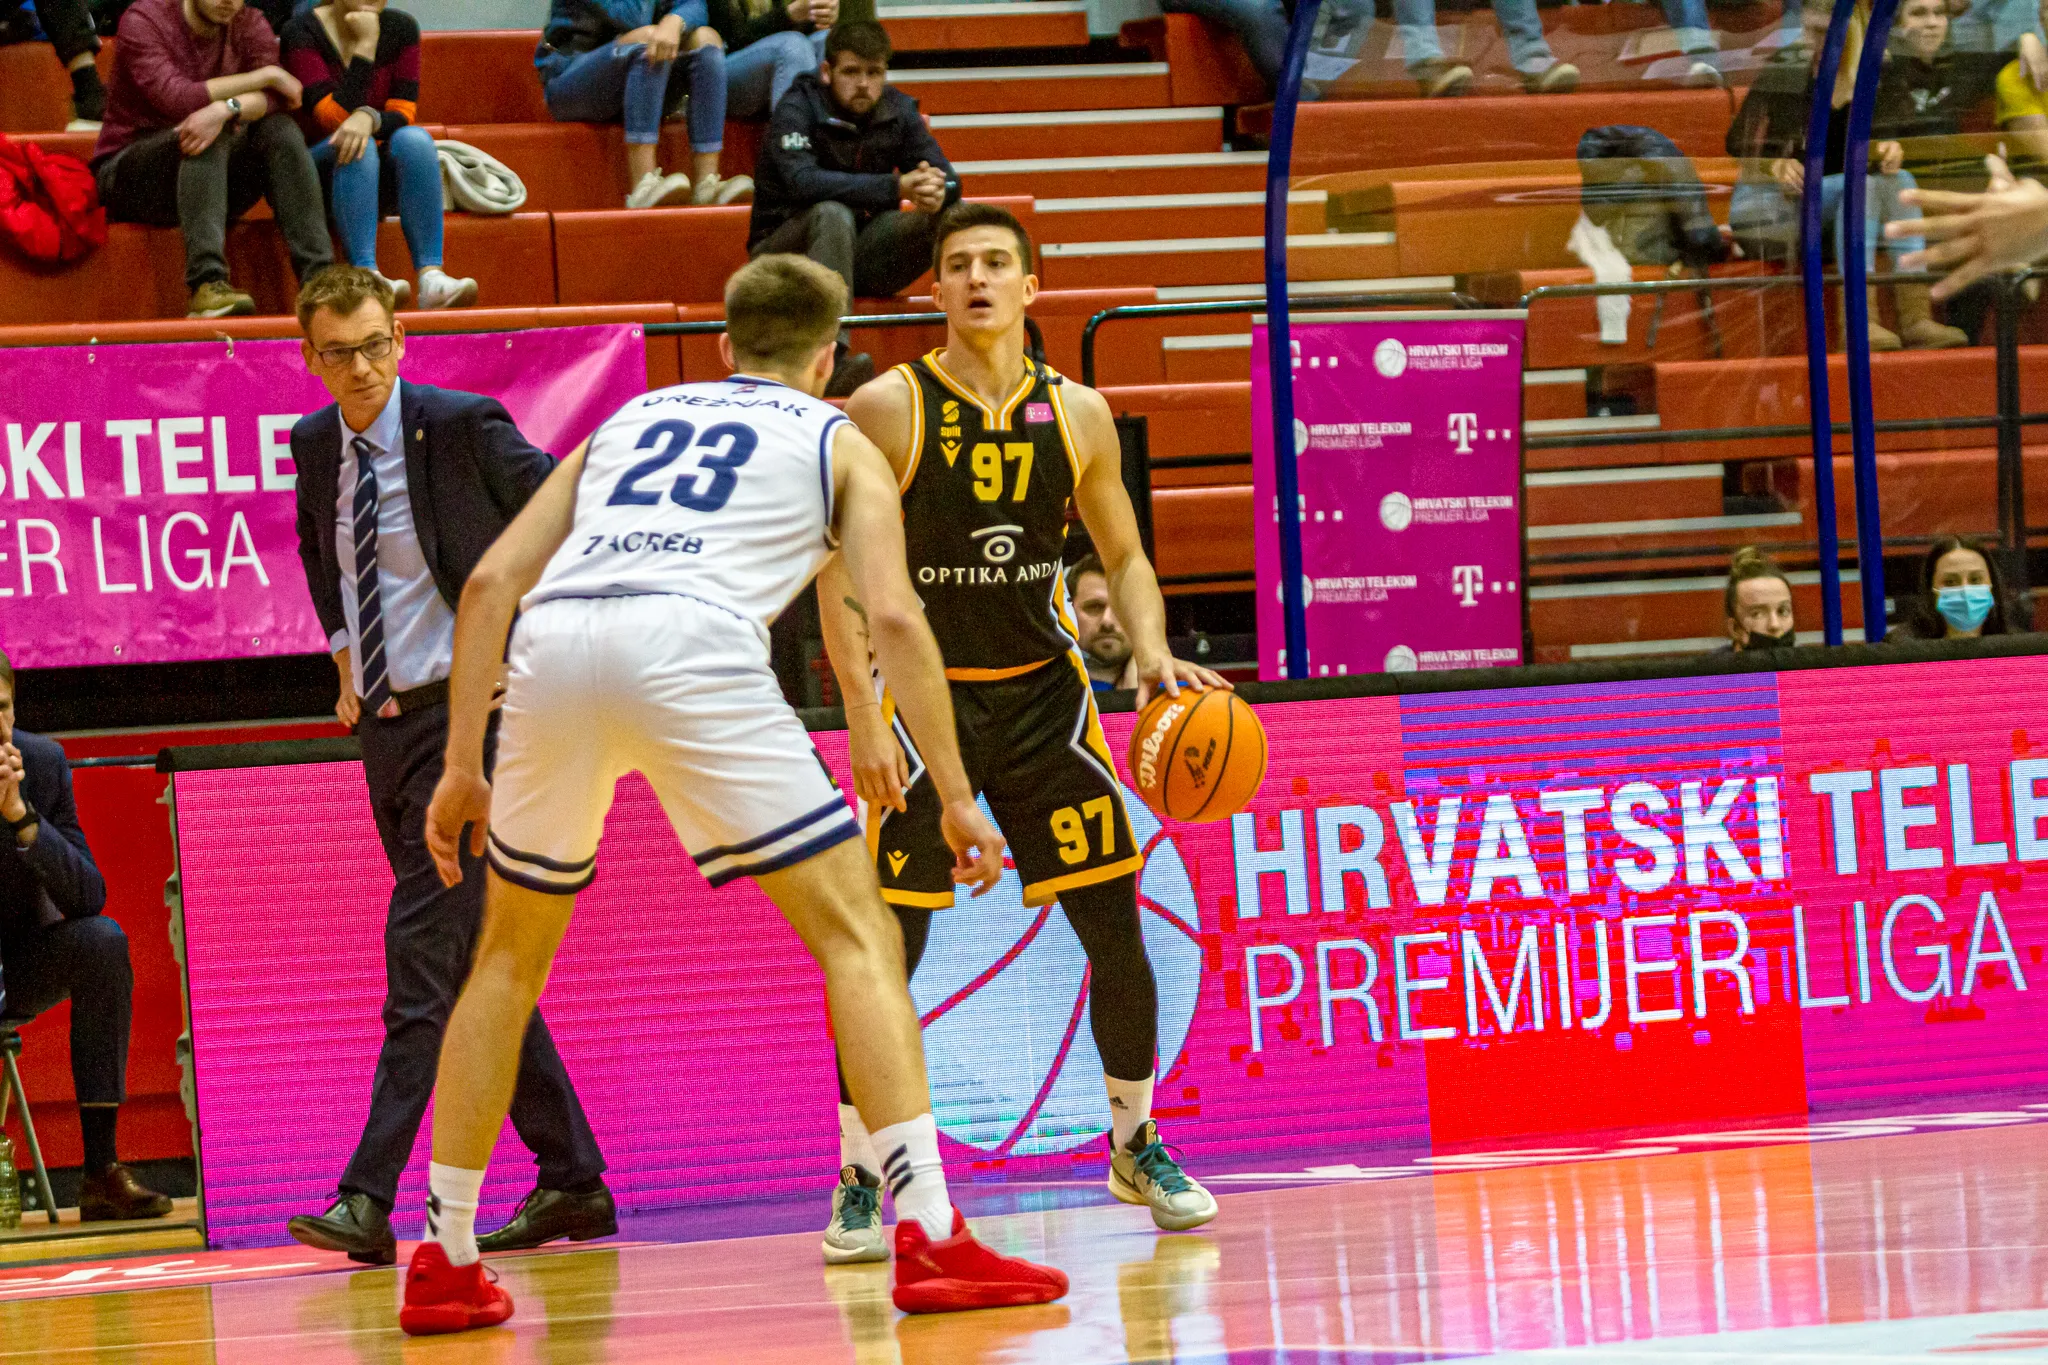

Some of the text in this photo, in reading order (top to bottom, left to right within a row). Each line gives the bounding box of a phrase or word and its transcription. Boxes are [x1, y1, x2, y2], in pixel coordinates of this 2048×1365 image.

[1408, 343, 1508, 357] HRVATSKI TELEKOM
[1310, 421, 1412, 436] HRVATSKI TELEKOM
[0, 421, 86, 500] KI
[605, 418, 759, 513] 23
[971, 442, 1034, 502] 97
[1414, 496, 1513, 509] HRVATSKI TELEKOM
[92, 511, 271, 593] LIGA
[918, 566, 1008, 584] OPTIKA
[1315, 575, 1417, 589] HRVATSKI TELEKOM
[1419, 648, 1518, 662] HRVATSKI TELEKOM
[1050, 795, 1115, 865] 97
[1231, 757, 2048, 919] HRVATSKI TELE
[1245, 891, 2029, 1053] PREMIJER LIGA
